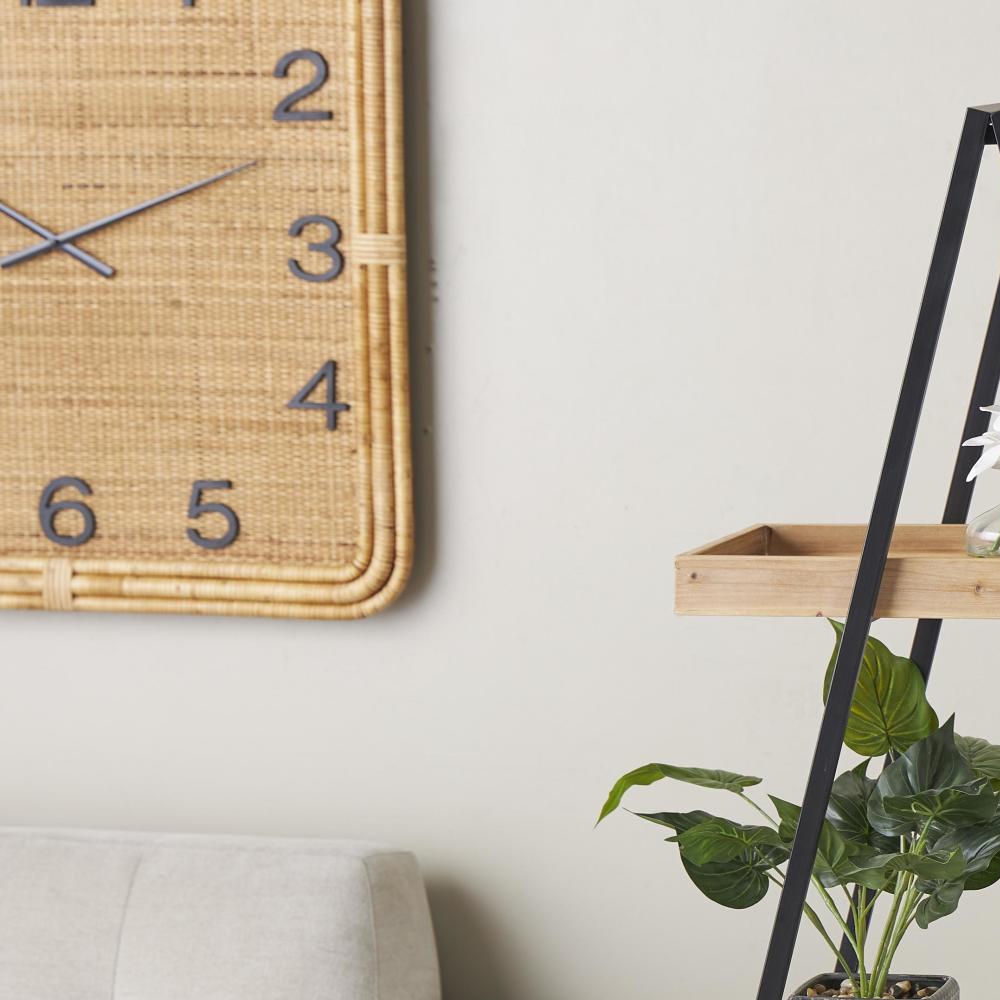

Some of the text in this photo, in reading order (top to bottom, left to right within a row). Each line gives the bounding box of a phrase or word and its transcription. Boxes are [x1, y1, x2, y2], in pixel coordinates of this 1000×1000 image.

[272, 49, 333, 121] 2
[287, 215, 345, 282] 3
[286, 360, 350, 431] 4
[38, 476, 97, 547] 6
[186, 479, 240, 550] 5
